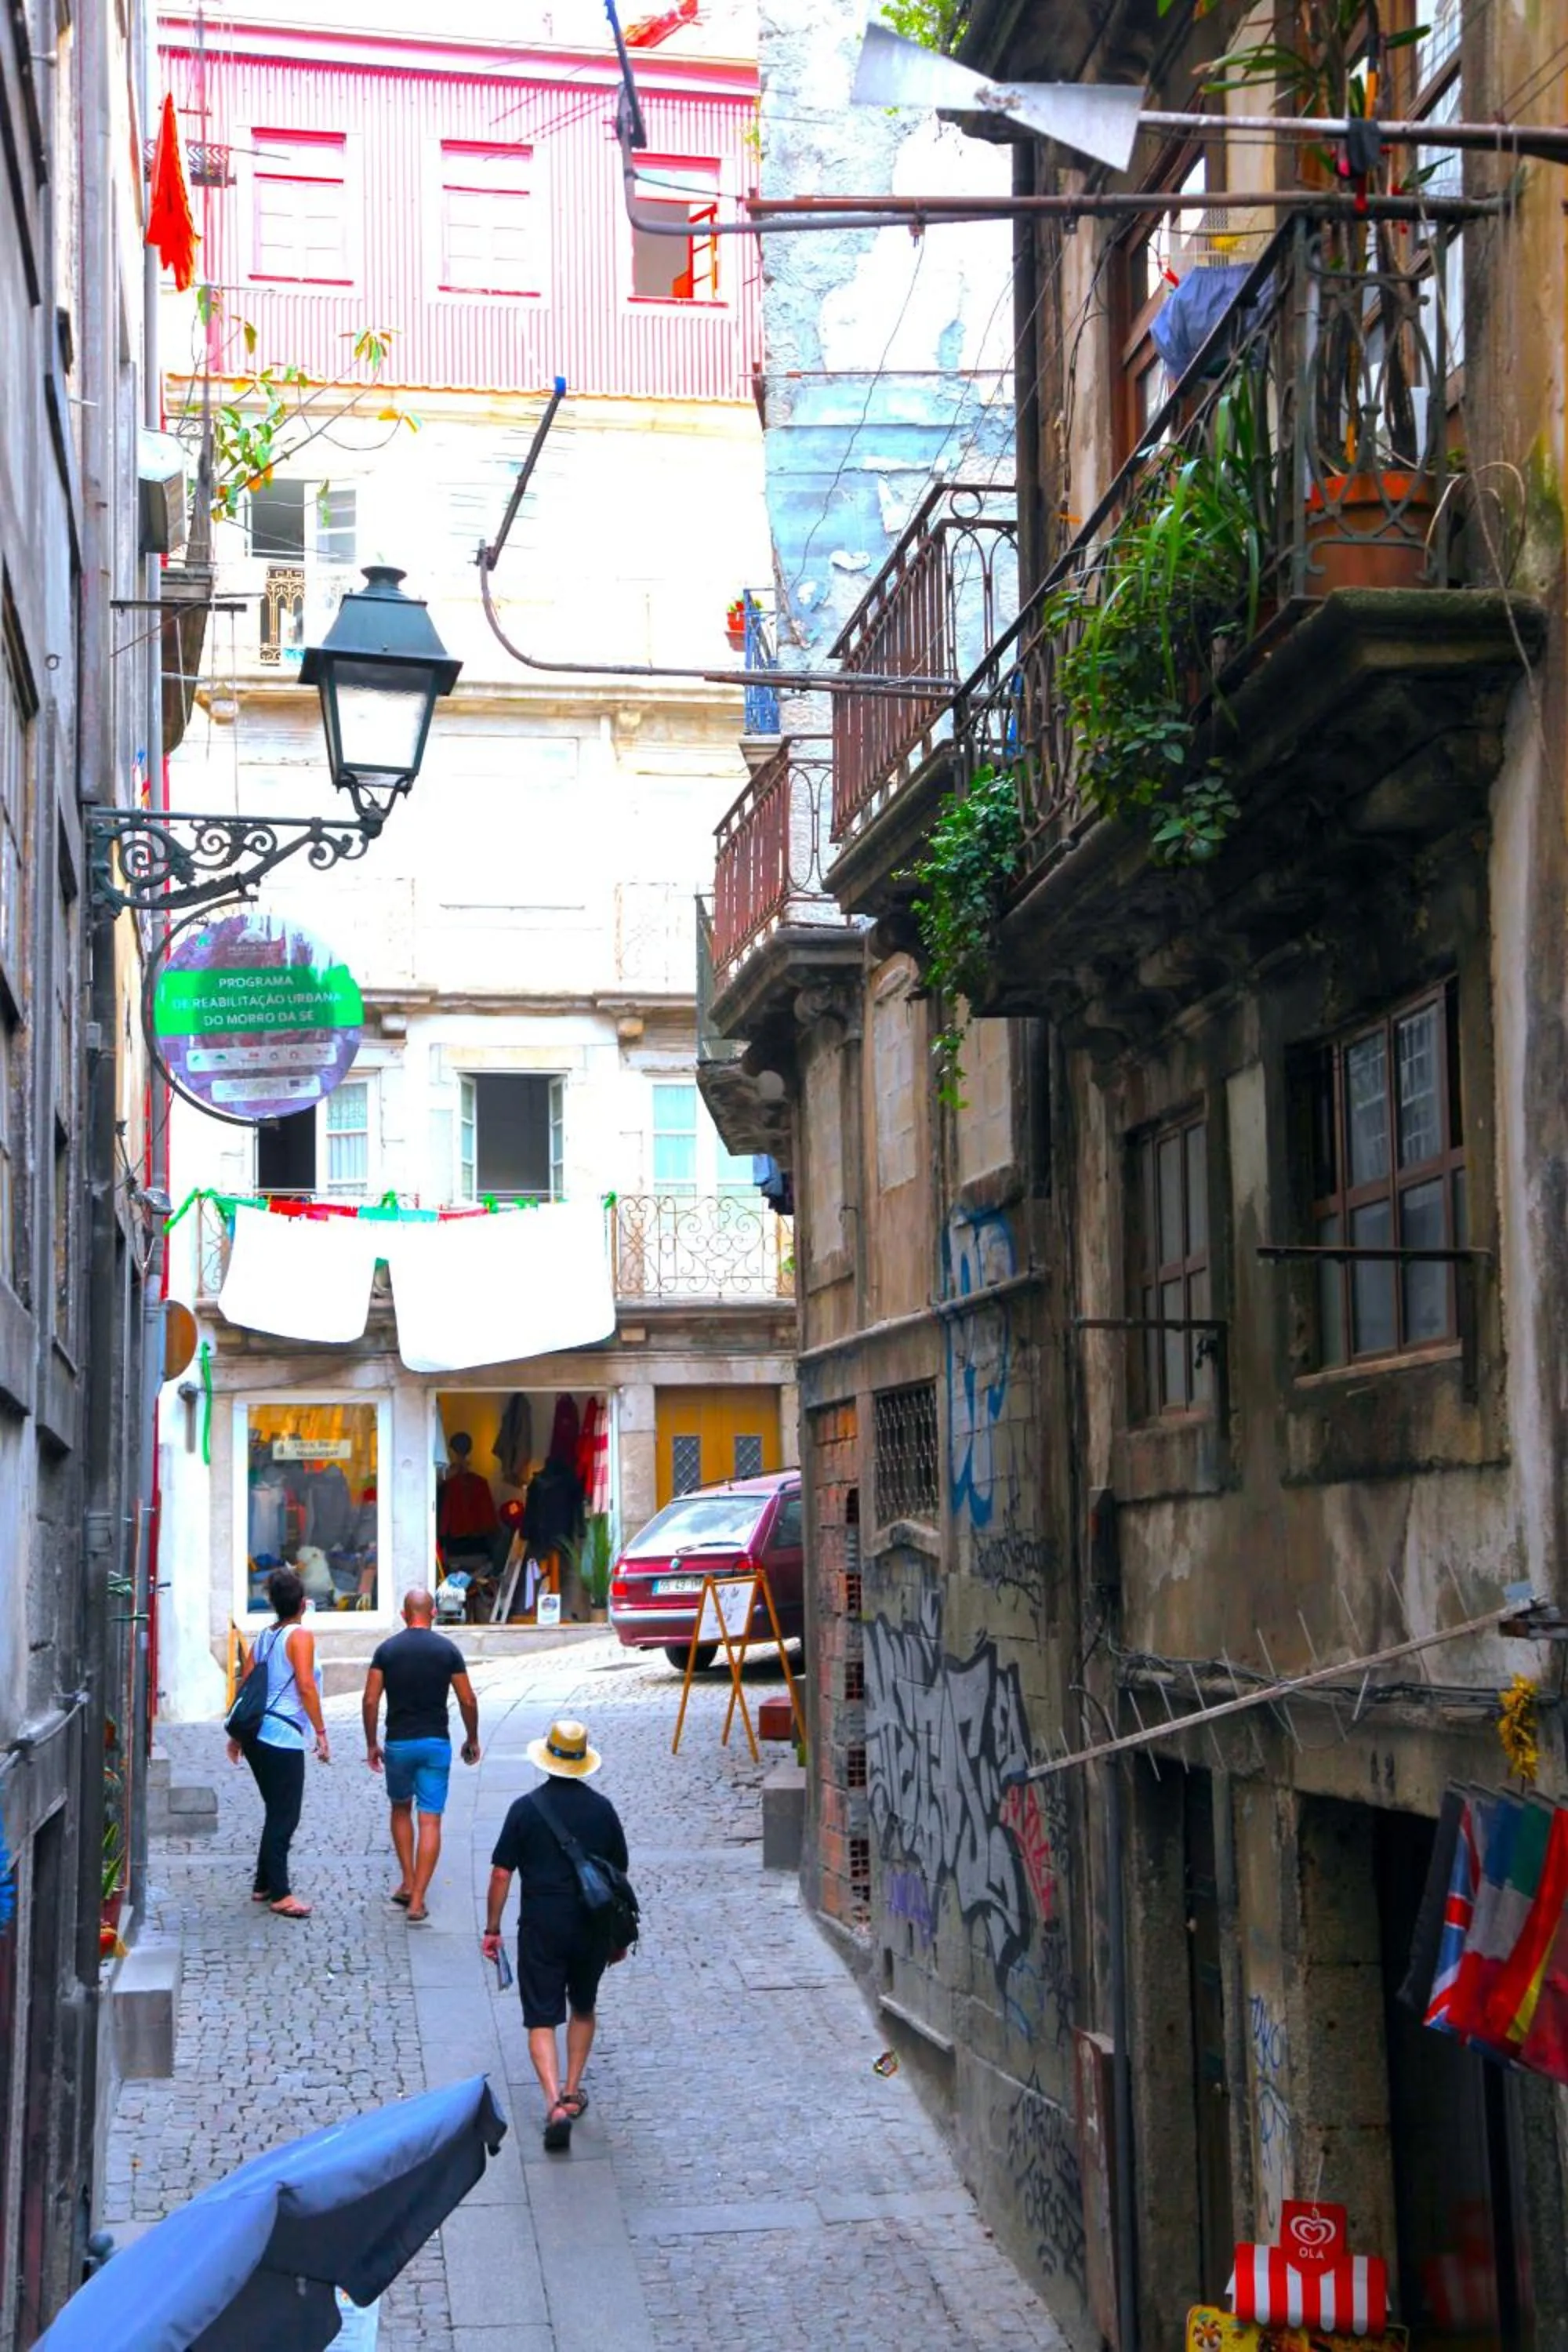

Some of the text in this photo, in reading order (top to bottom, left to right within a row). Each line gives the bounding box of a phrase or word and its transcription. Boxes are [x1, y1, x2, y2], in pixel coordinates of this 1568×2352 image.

[219, 975, 294, 989] PROGRAMA
[288, 992, 342, 1004] URBANA
[203, 1014, 224, 1026] DO
[227, 1012, 275, 1025] MORRO
[278, 1011, 296, 1022] DA
[1298, 2246, 1325, 2260] OLA
